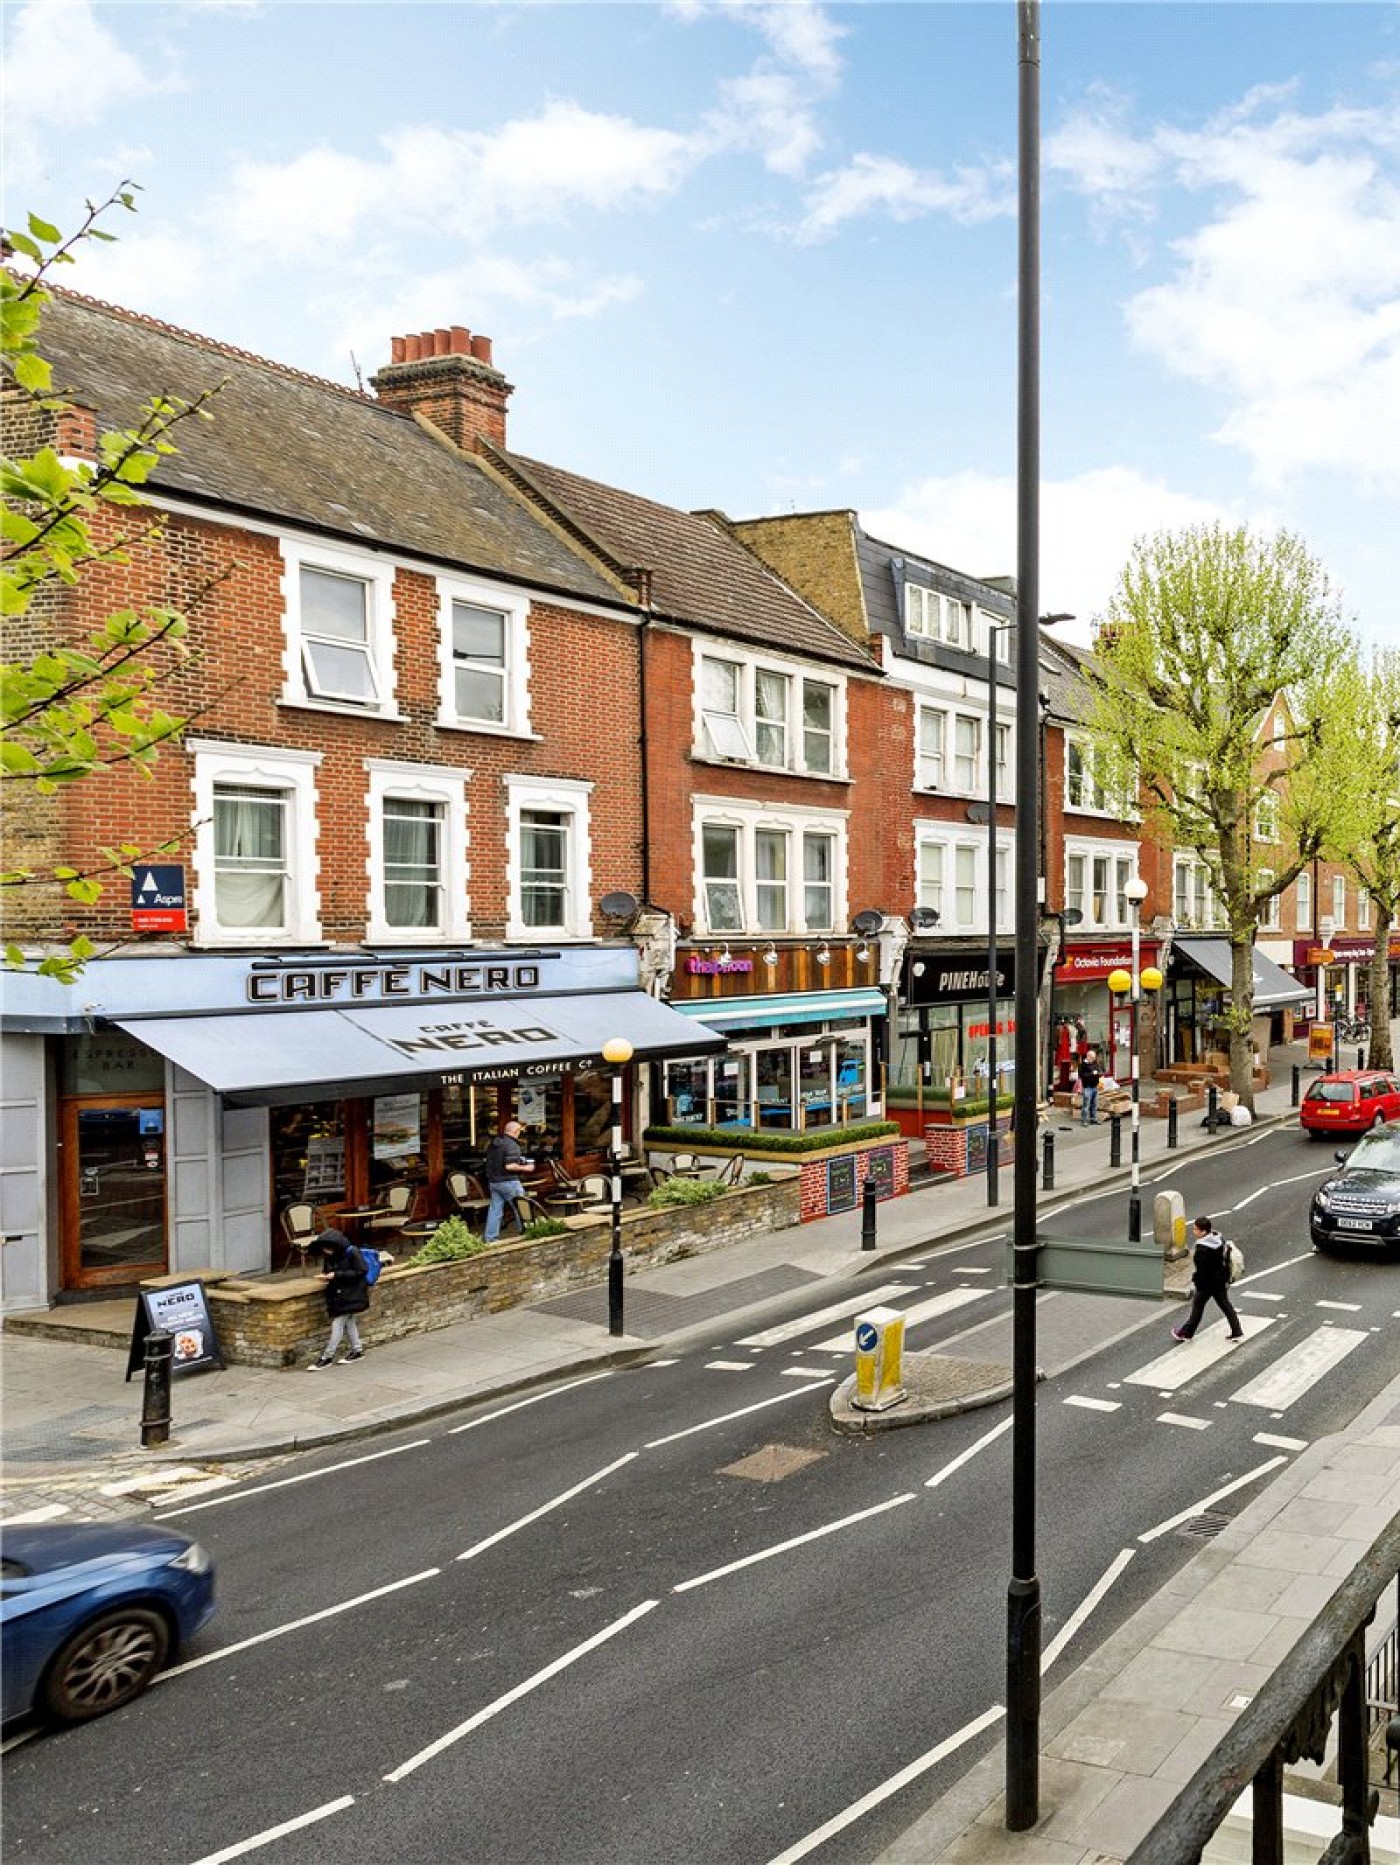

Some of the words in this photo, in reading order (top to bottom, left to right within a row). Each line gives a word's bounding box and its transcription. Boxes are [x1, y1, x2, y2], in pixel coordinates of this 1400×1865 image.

[419, 965, 541, 994] NERO
[390, 1026, 559, 1055] NERO
[440, 1073, 463, 1085] THE
[471, 1068, 519, 1082] ITALIAN
[525, 1061, 572, 1076] COFFEE
